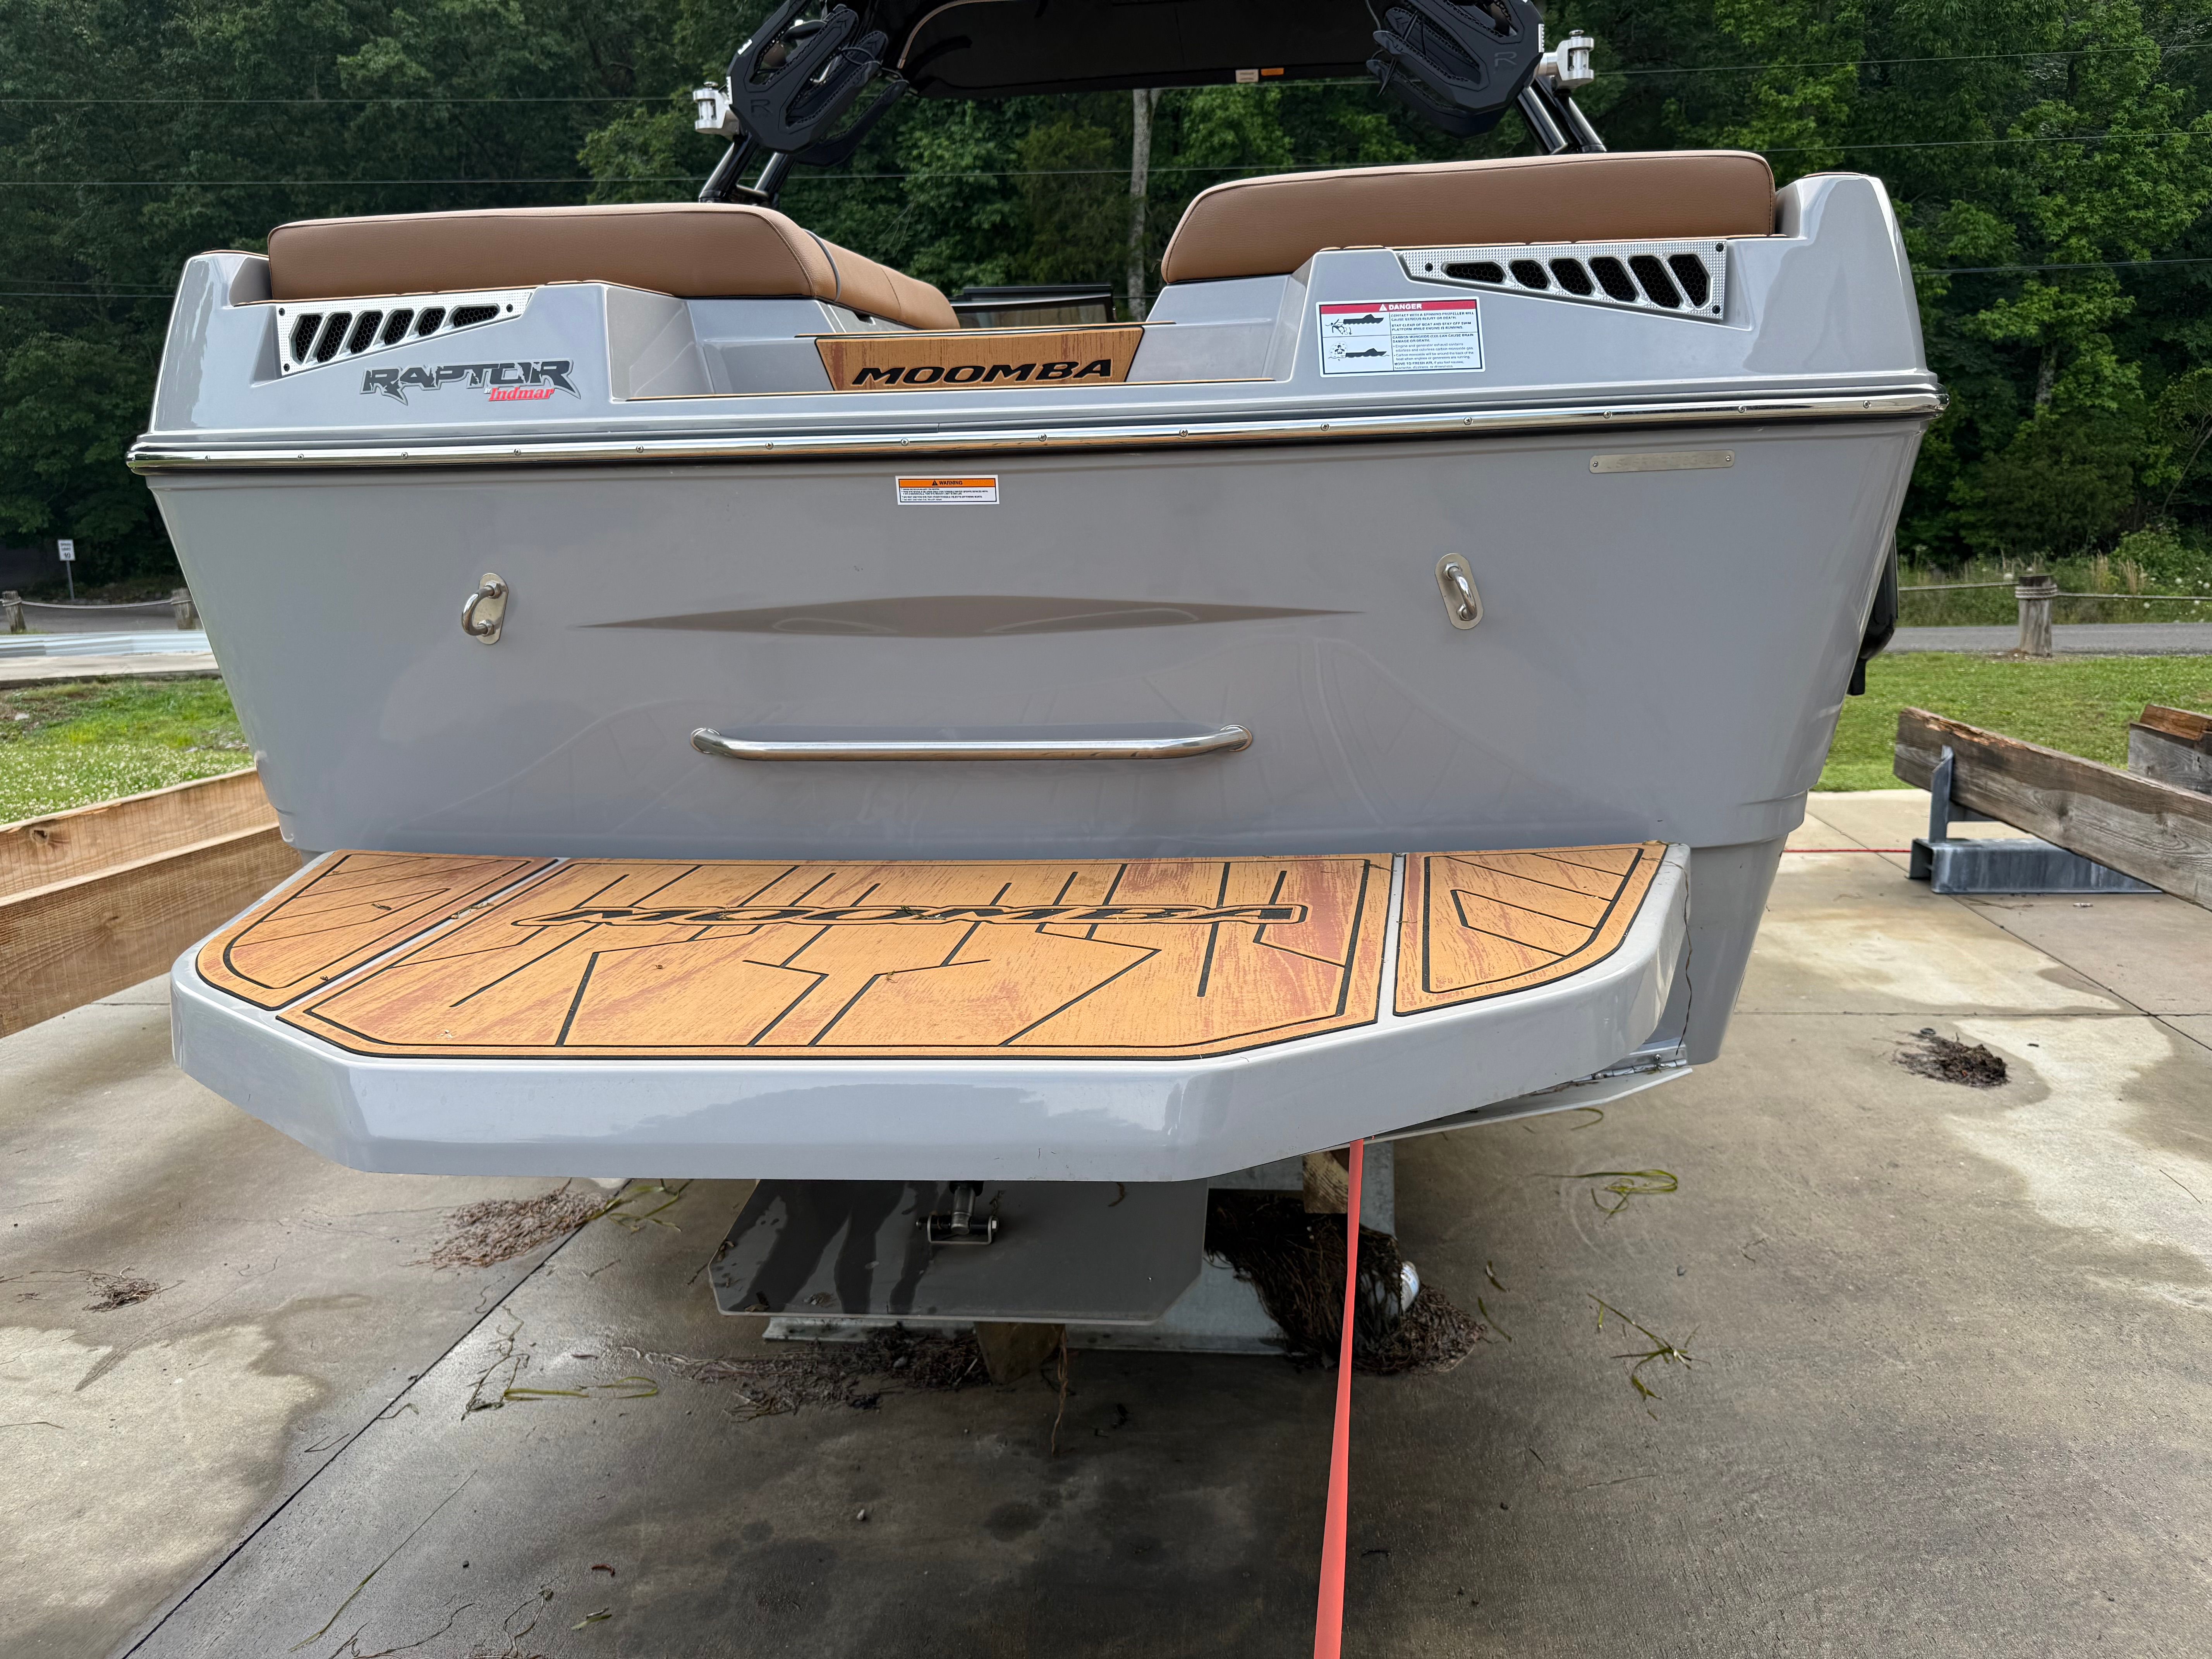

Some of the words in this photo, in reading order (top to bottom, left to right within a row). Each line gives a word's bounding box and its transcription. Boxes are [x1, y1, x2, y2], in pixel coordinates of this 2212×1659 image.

[360, 358, 581, 406] RAPTOR
[852, 359, 1112, 385] MOOMBA
[489, 387, 554, 401] Indmar
[531, 906, 1297, 923] MOOMBA
